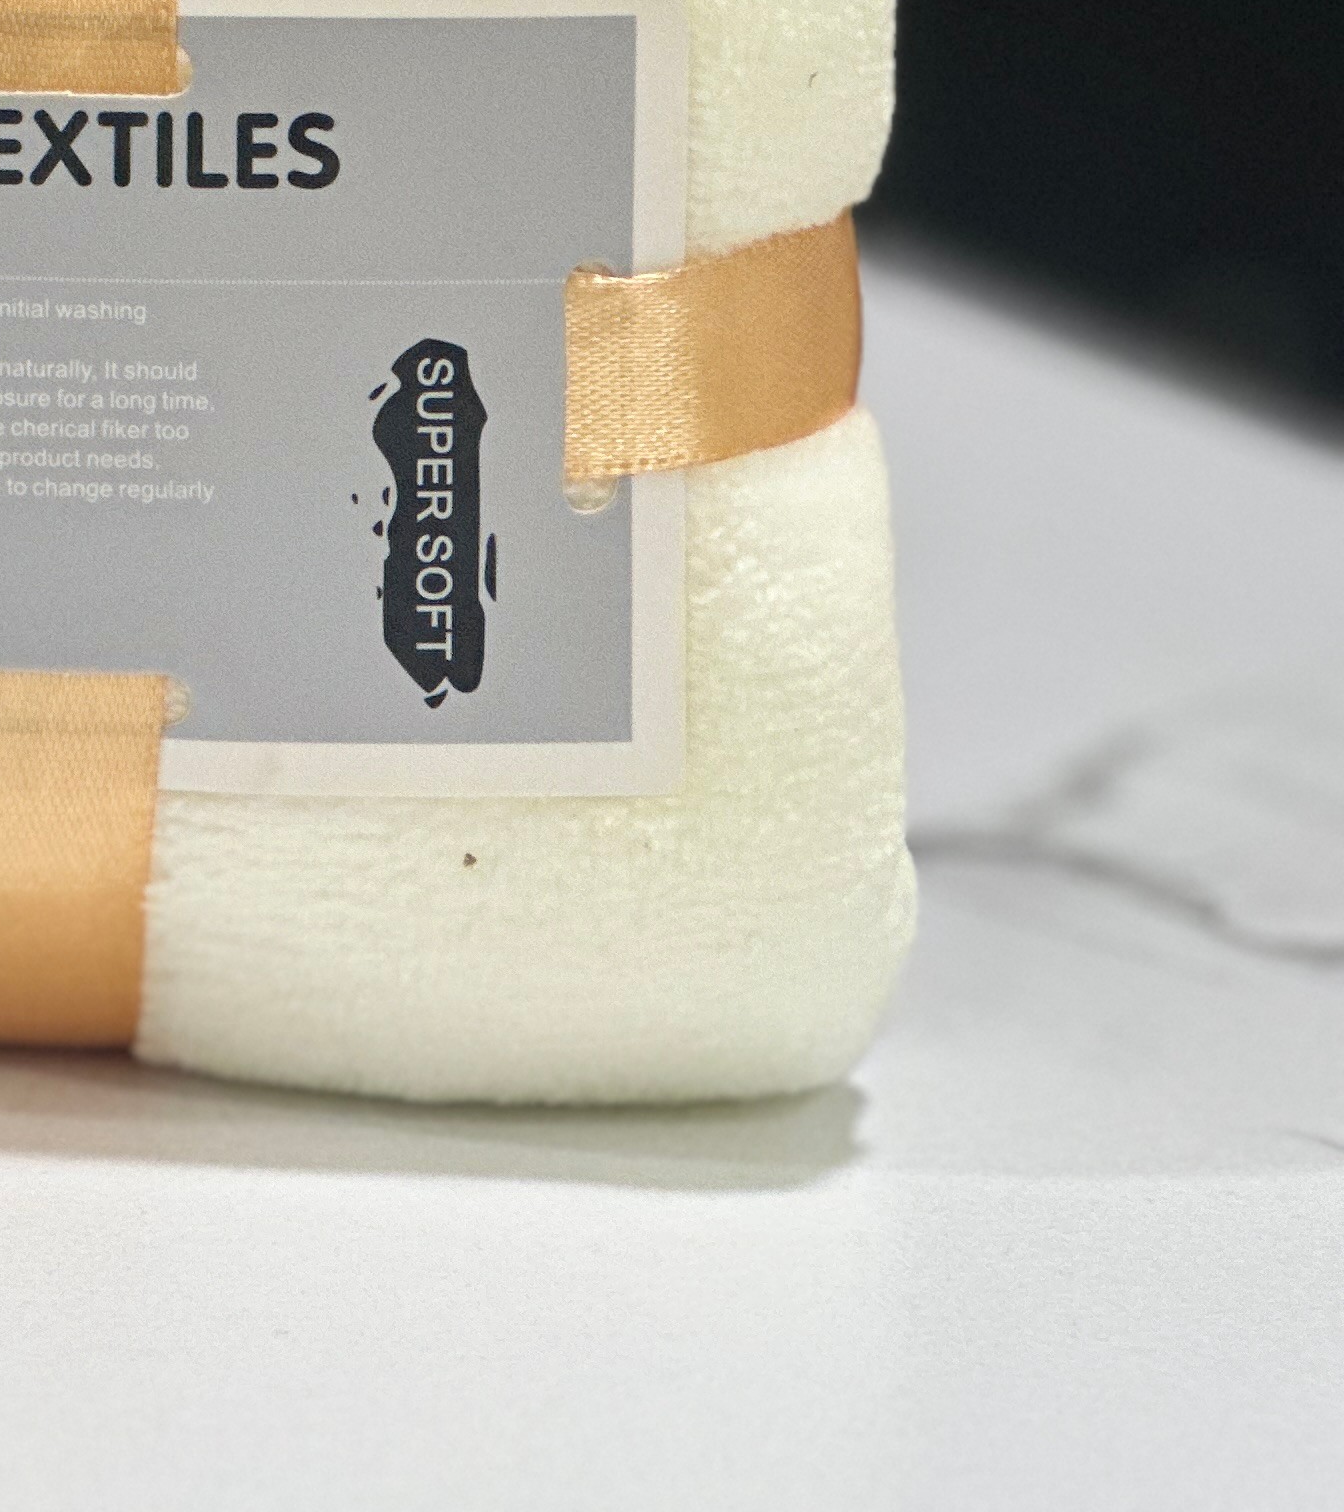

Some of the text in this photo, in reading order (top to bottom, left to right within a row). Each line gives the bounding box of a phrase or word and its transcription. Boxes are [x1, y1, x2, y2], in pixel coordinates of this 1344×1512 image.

[55, 300, 147, 325] washing
[104, 360, 119, 378] It
[123, 360, 198, 381] should
[57, 388, 86, 409] for
[90, 392, 104, 409] a
[110, 390, 156, 414] long
[154, 421, 190, 439] too
[7, 478, 27, 496] to
[31, 478, 113, 503] change
[119, 480, 215, 504] regularly
[415, 356, 455, 662] SUPER SOFT
